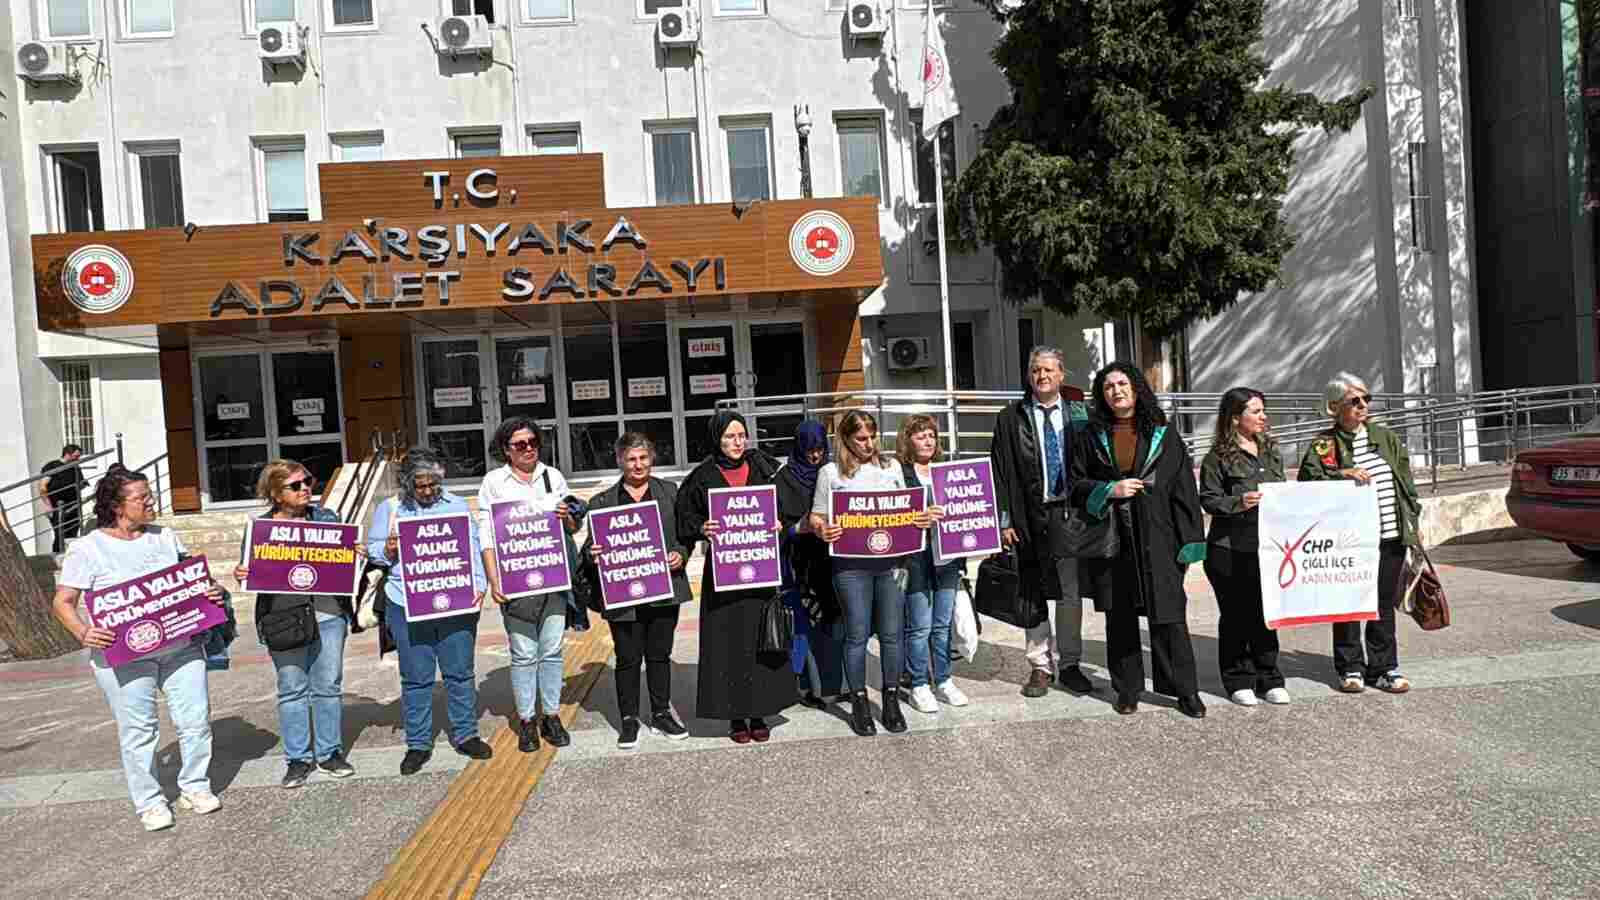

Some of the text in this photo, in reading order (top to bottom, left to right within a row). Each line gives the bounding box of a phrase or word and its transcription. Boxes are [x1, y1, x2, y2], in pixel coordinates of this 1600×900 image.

[424, 168, 517, 208] T.C.
[282, 215, 647, 269] KARŞIYAKA
[210, 256, 725, 318] ADALET SARAYI
[947, 468, 977, 482] ASLA
[944, 484, 984, 499] YALNIZ
[727, 496, 760, 510] ASLA
[848, 495, 912, 511] ASLA YALNIZ
[944, 500, 993, 516] YÜRÜME-
[505, 520, 551, 536] YALNIZ
[609, 512, 643, 530] ASLA
[722, 513, 766, 528] YALNIZ
[834, 510, 922, 529] YÜRÜMEYECEKSİ
[941, 516, 996, 533] YECEKSİN
[269, 526, 342, 545] ASLA YALNIZ
[416, 523, 452, 538] ASLA
[606, 528, 651, 547] YALNIZ
[716, 529, 774, 545] YÜRÜME-
[253, 542, 354, 564] YÜRÜMEYECEKSİN
[412, 540, 459, 557] YALNIZ
[500, 536, 561, 555] YÜRÜME-
[1301, 539, 1334, 555] CHP
[501, 552, 564, 572] YECEKSİN
[601, 545, 662, 566] YÜRÜME-
[716, 546, 776, 564] YECEKSİN
[1331, 557, 1356, 571] İLÇE
[406, 558, 469, 576] YÜRÜME-
[603, 561, 666, 583] YECEKSİN
[93, 561, 208, 616] ASLA YALNIZ
[407, 574, 472, 595] YECEKSİN
